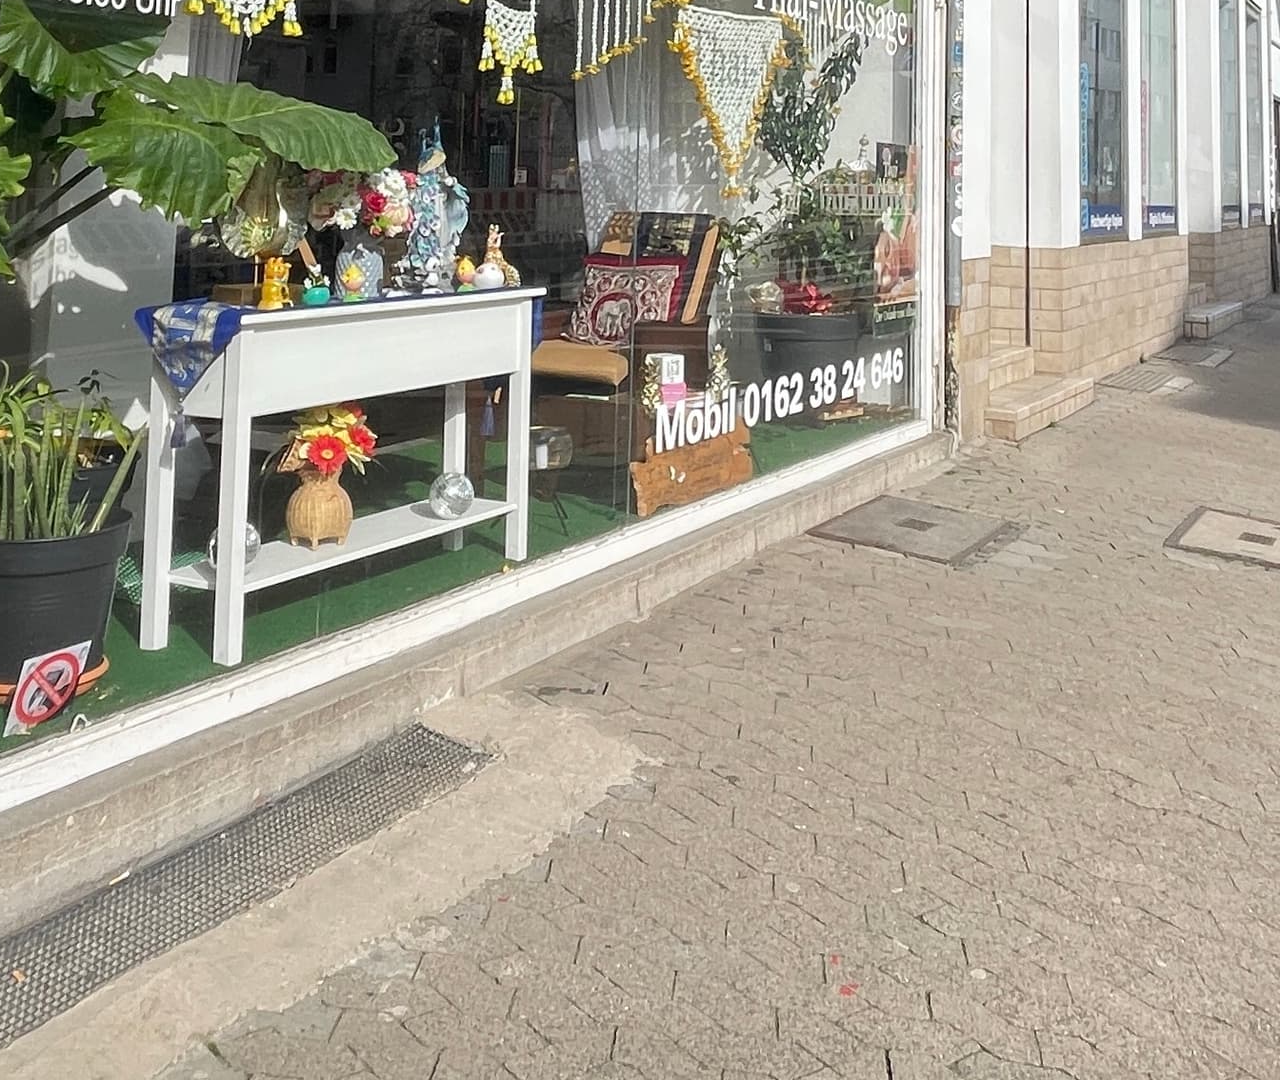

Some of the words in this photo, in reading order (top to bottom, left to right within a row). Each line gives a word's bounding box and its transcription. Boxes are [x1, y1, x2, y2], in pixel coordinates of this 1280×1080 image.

[654, 387, 737, 454] Mobil
[743, 370, 804, 428] 0162
[808, 363, 838, 410] 38
[840, 355, 866, 400] 24
[871, 346, 904, 391] 646
